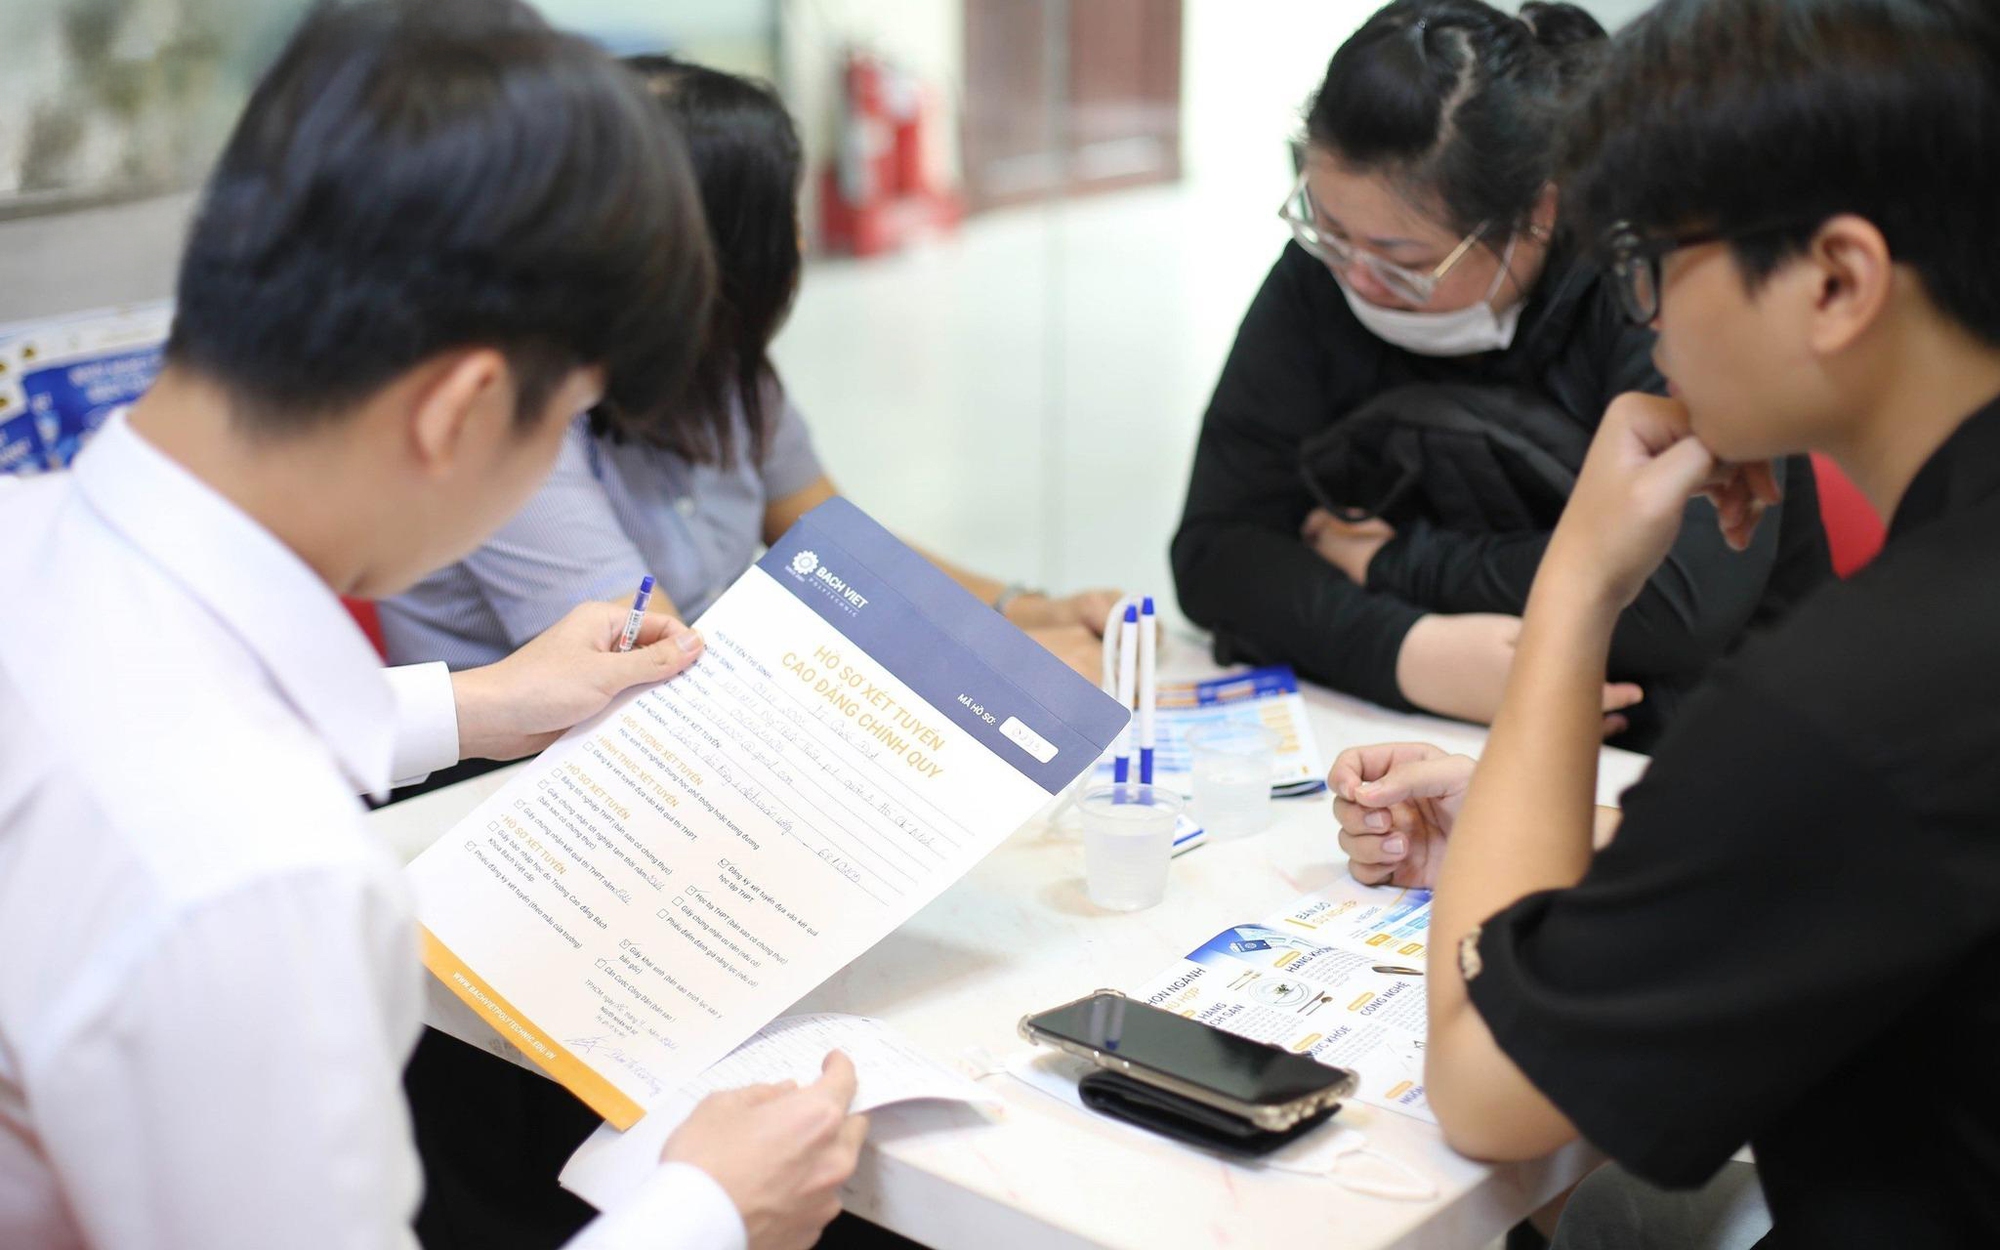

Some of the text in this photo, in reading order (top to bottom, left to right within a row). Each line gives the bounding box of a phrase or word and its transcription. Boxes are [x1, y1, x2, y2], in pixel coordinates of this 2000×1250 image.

[780, 651, 818, 683] CAO
[856, 711, 911, 755] CHÍNH
[904, 750, 943, 779] QUY
[812, 644, 843, 670] HỒ
[837, 665, 866, 688] SƠ
[860, 682, 897, 711] XÉT
